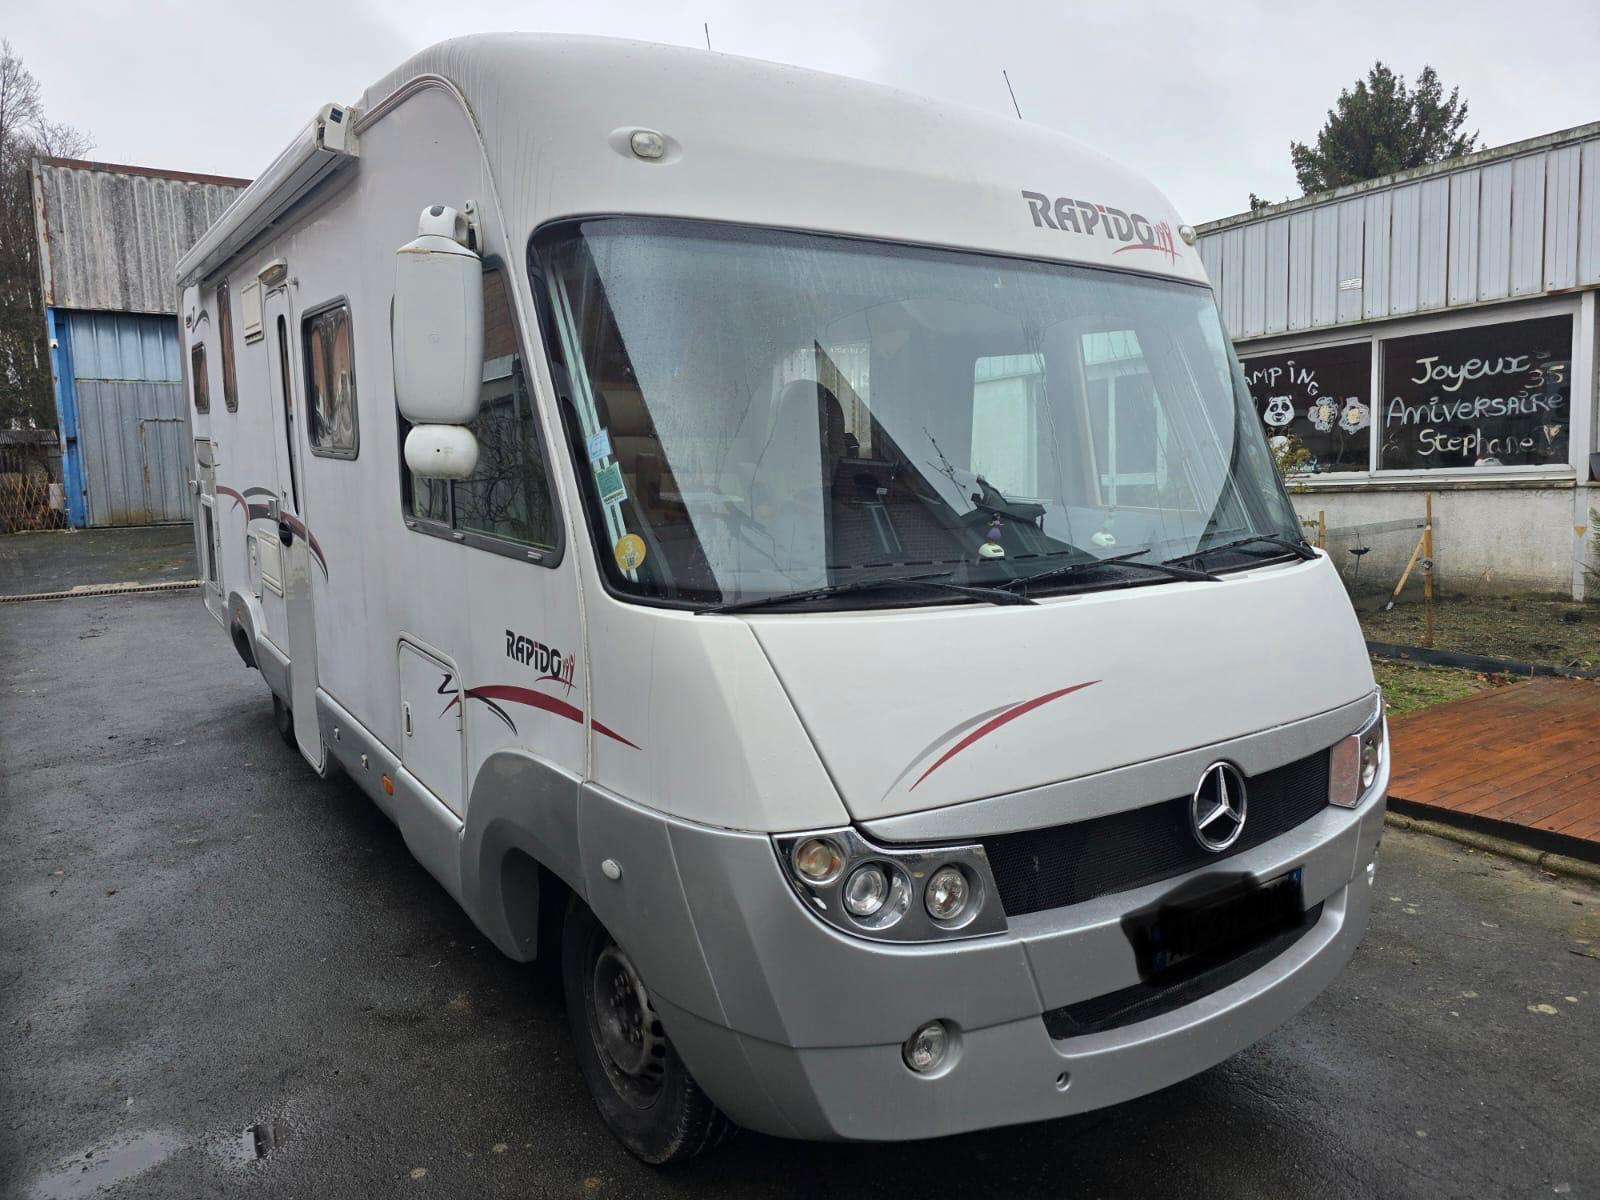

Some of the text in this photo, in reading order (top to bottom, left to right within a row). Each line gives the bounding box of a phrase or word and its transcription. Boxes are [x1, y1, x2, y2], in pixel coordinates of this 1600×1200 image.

[1411, 355, 1531, 391] Joyeux
[1524, 364, 1565, 389] 35
[1417, 427, 1536, 456] Stephane
